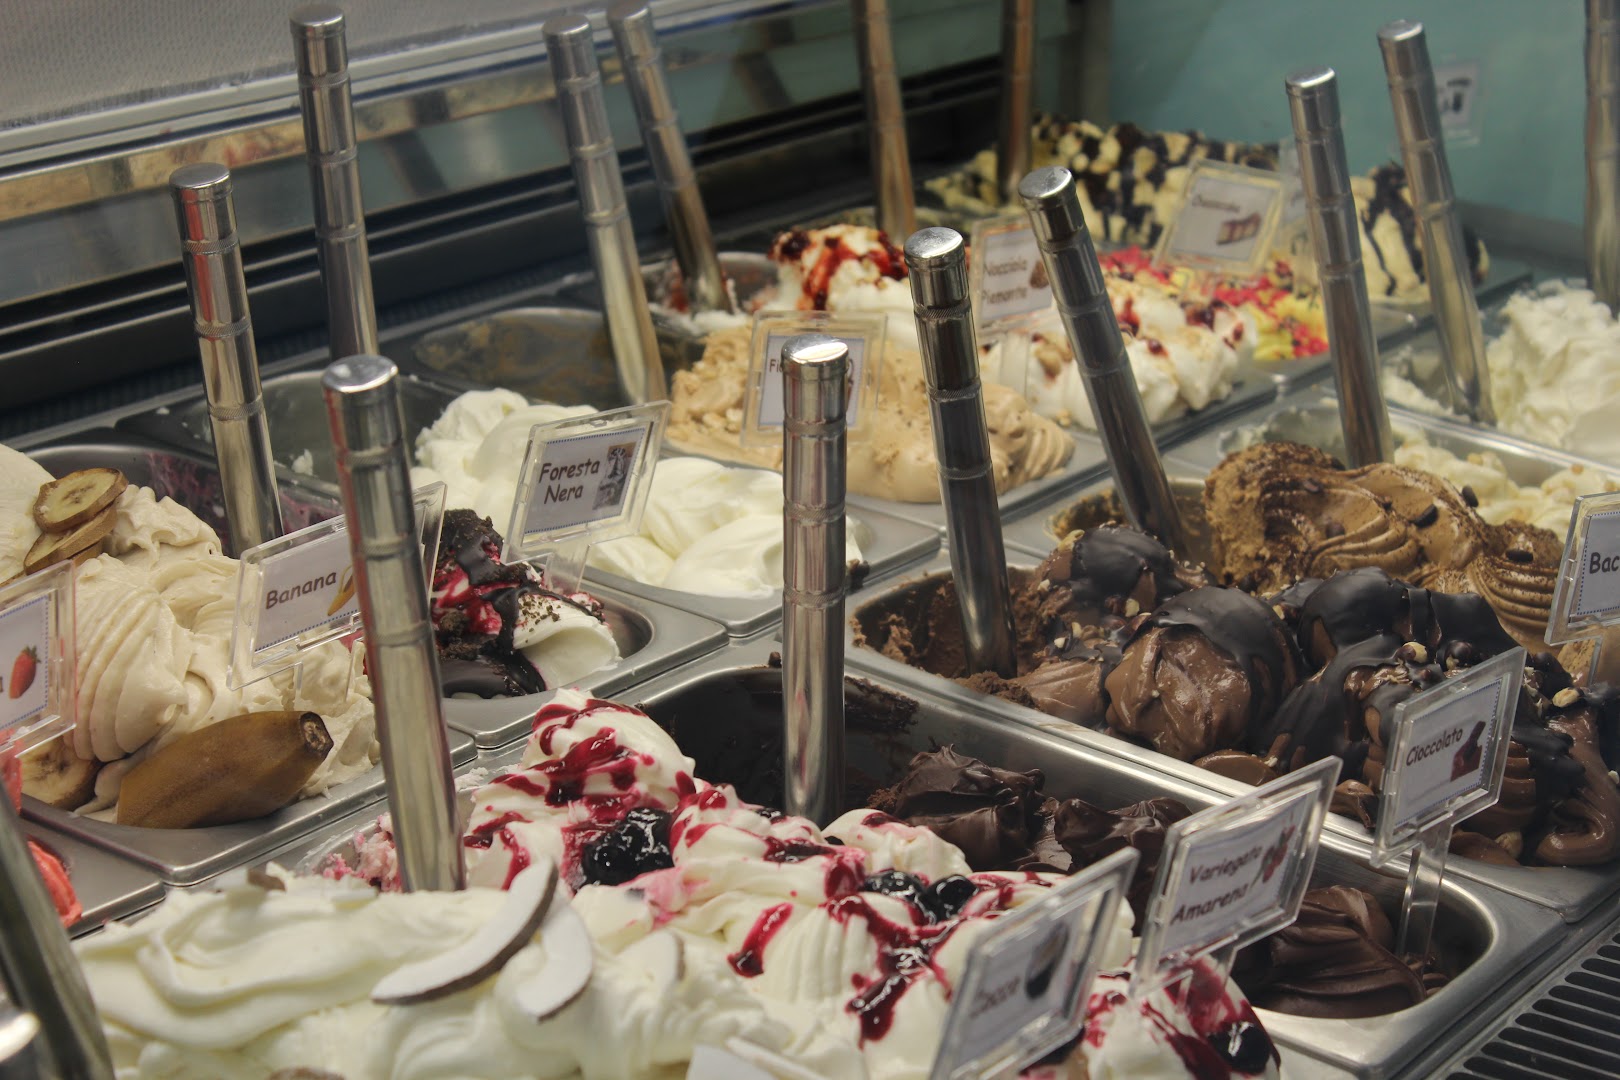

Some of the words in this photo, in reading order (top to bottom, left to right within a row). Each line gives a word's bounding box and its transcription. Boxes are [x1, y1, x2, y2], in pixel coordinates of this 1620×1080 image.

[539, 458, 600, 483] Foresta
[543, 484, 584, 504] Nera
[265, 572, 337, 609] Banana
[1406, 728, 1463, 766] Cioccolato
